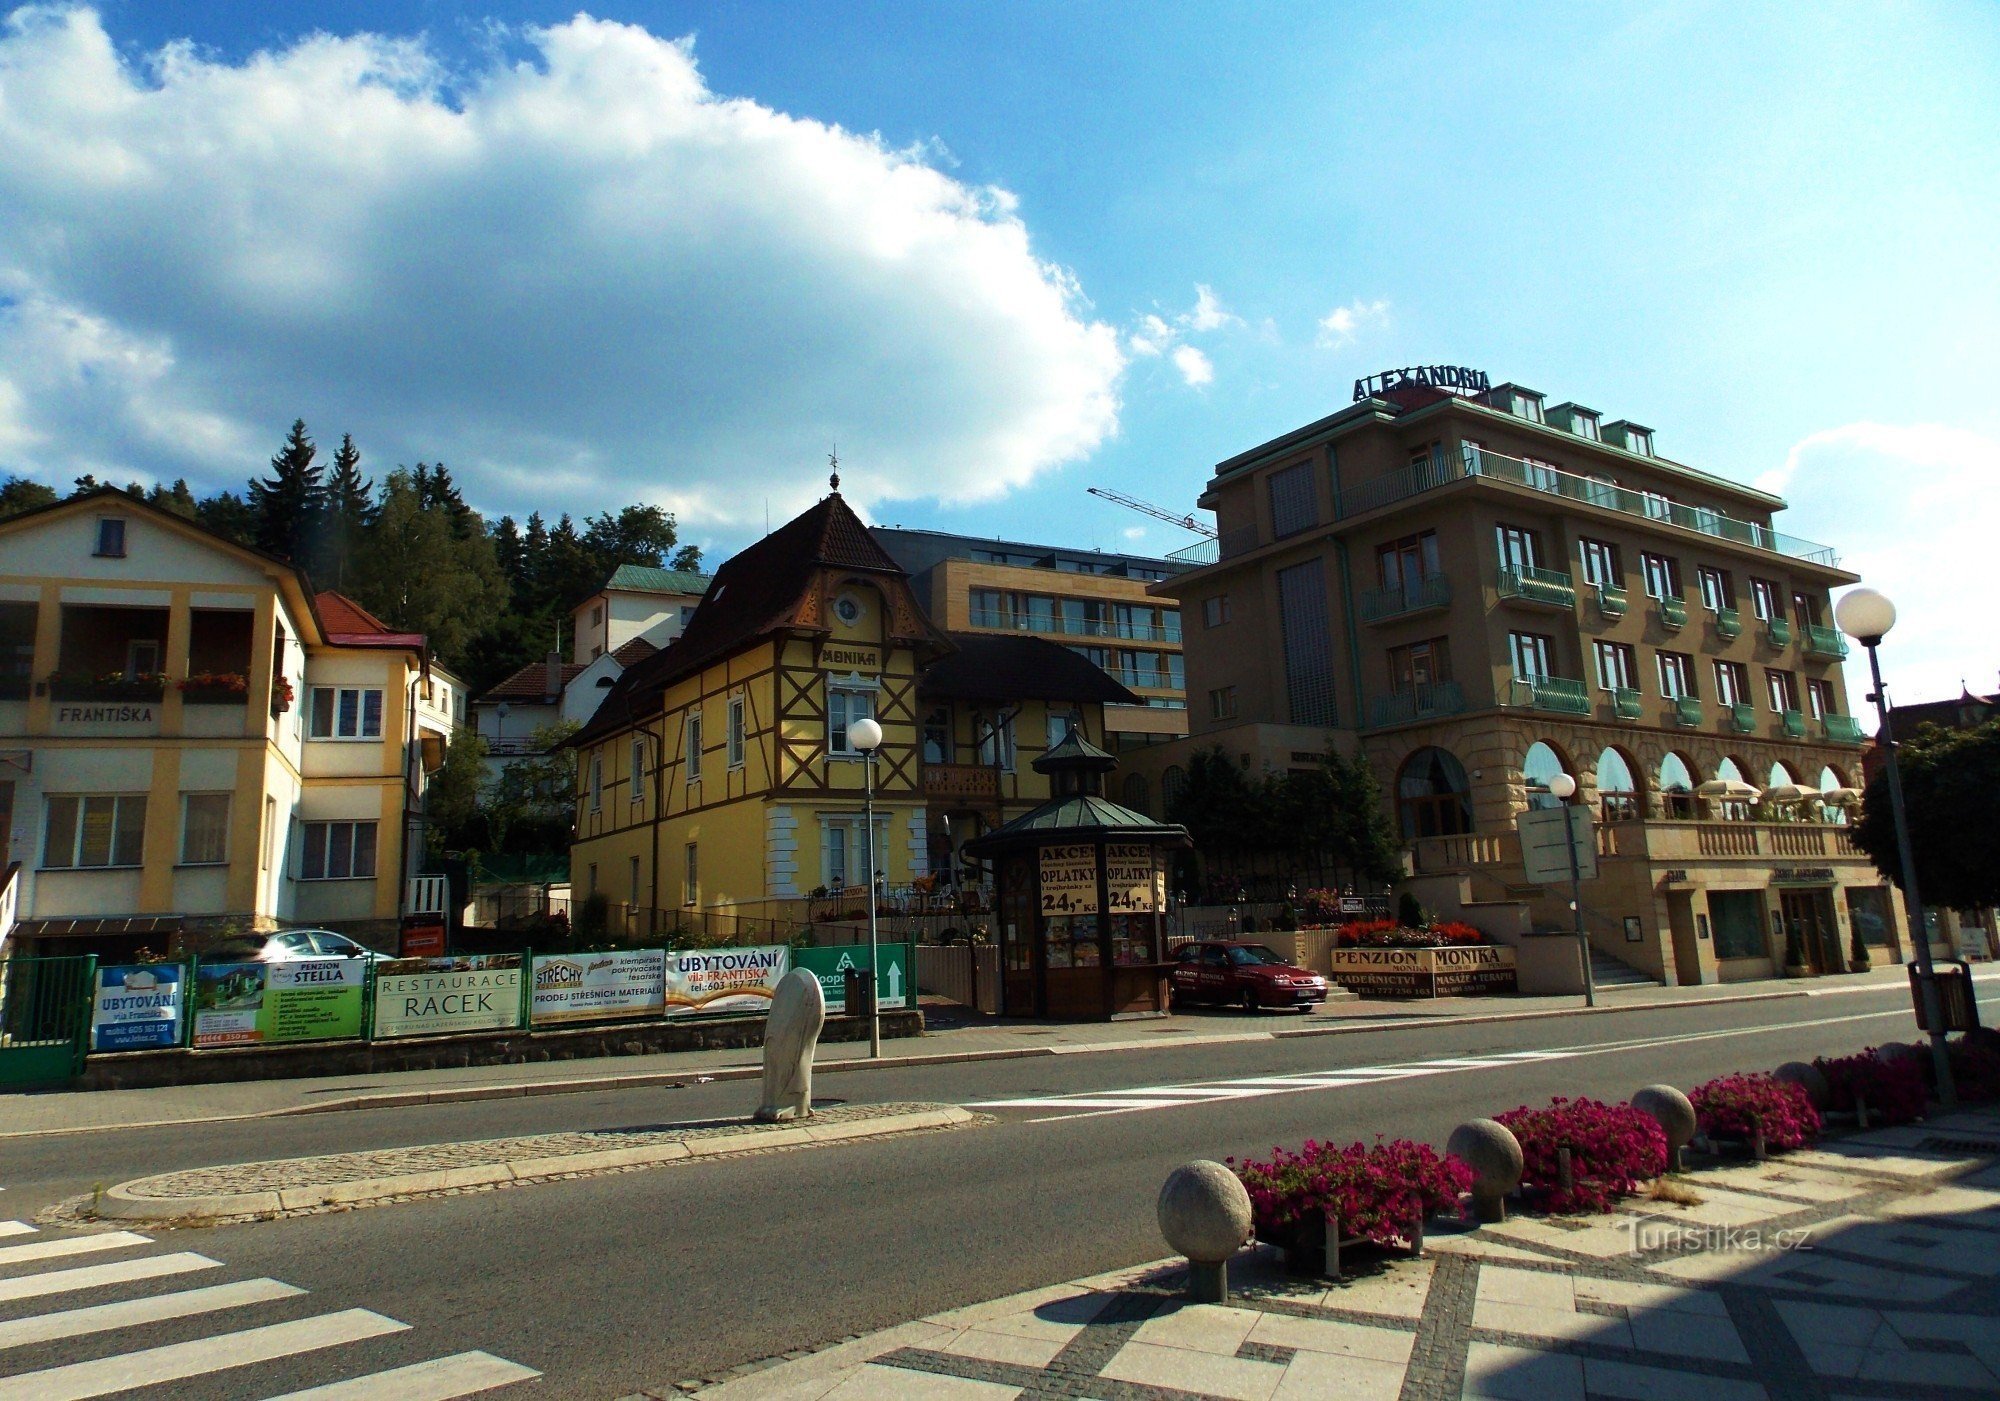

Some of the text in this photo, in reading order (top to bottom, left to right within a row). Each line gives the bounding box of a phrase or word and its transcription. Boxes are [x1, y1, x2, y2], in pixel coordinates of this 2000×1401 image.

[1353, 365, 1491, 401] ALEXANDRIA
[822, 649, 876, 665] MONIKA
[59, 707, 152, 722] FRANTIŠKA
[1042, 846, 1095, 860] AKCE!
[1107, 845, 1151, 858] AKCE!
[1041, 868, 1096, 883] OPLATKY
[1107, 867, 1151, 880] OPLATKY
[679, 950, 777, 972] UBYTOVÁNÍ
[1335, 952, 1418, 965] PENZION
[1435, 949, 1500, 966] MONIKA
[301, 962, 340, 971] PENZION
[1392, 965, 1428, 973] MONIKA
[294, 969, 344, 983] STELLA
[687, 968, 769, 982] vila FRANTIŠKA
[1336, 973, 1416, 985] KADEŘNICTVÍ
[382, 973, 518, 993] RESTAURACE
[747, 979, 765, 988] 774
[102, 991, 177, 1010] UBYTOVÁNÍ
[535, 992, 569, 1003] PRODEJ
[571, 988, 616, 1000] STŘEŠNÍCH
[405, 992, 494, 1017] RACEK
[225, 1033, 241, 1041] 350
